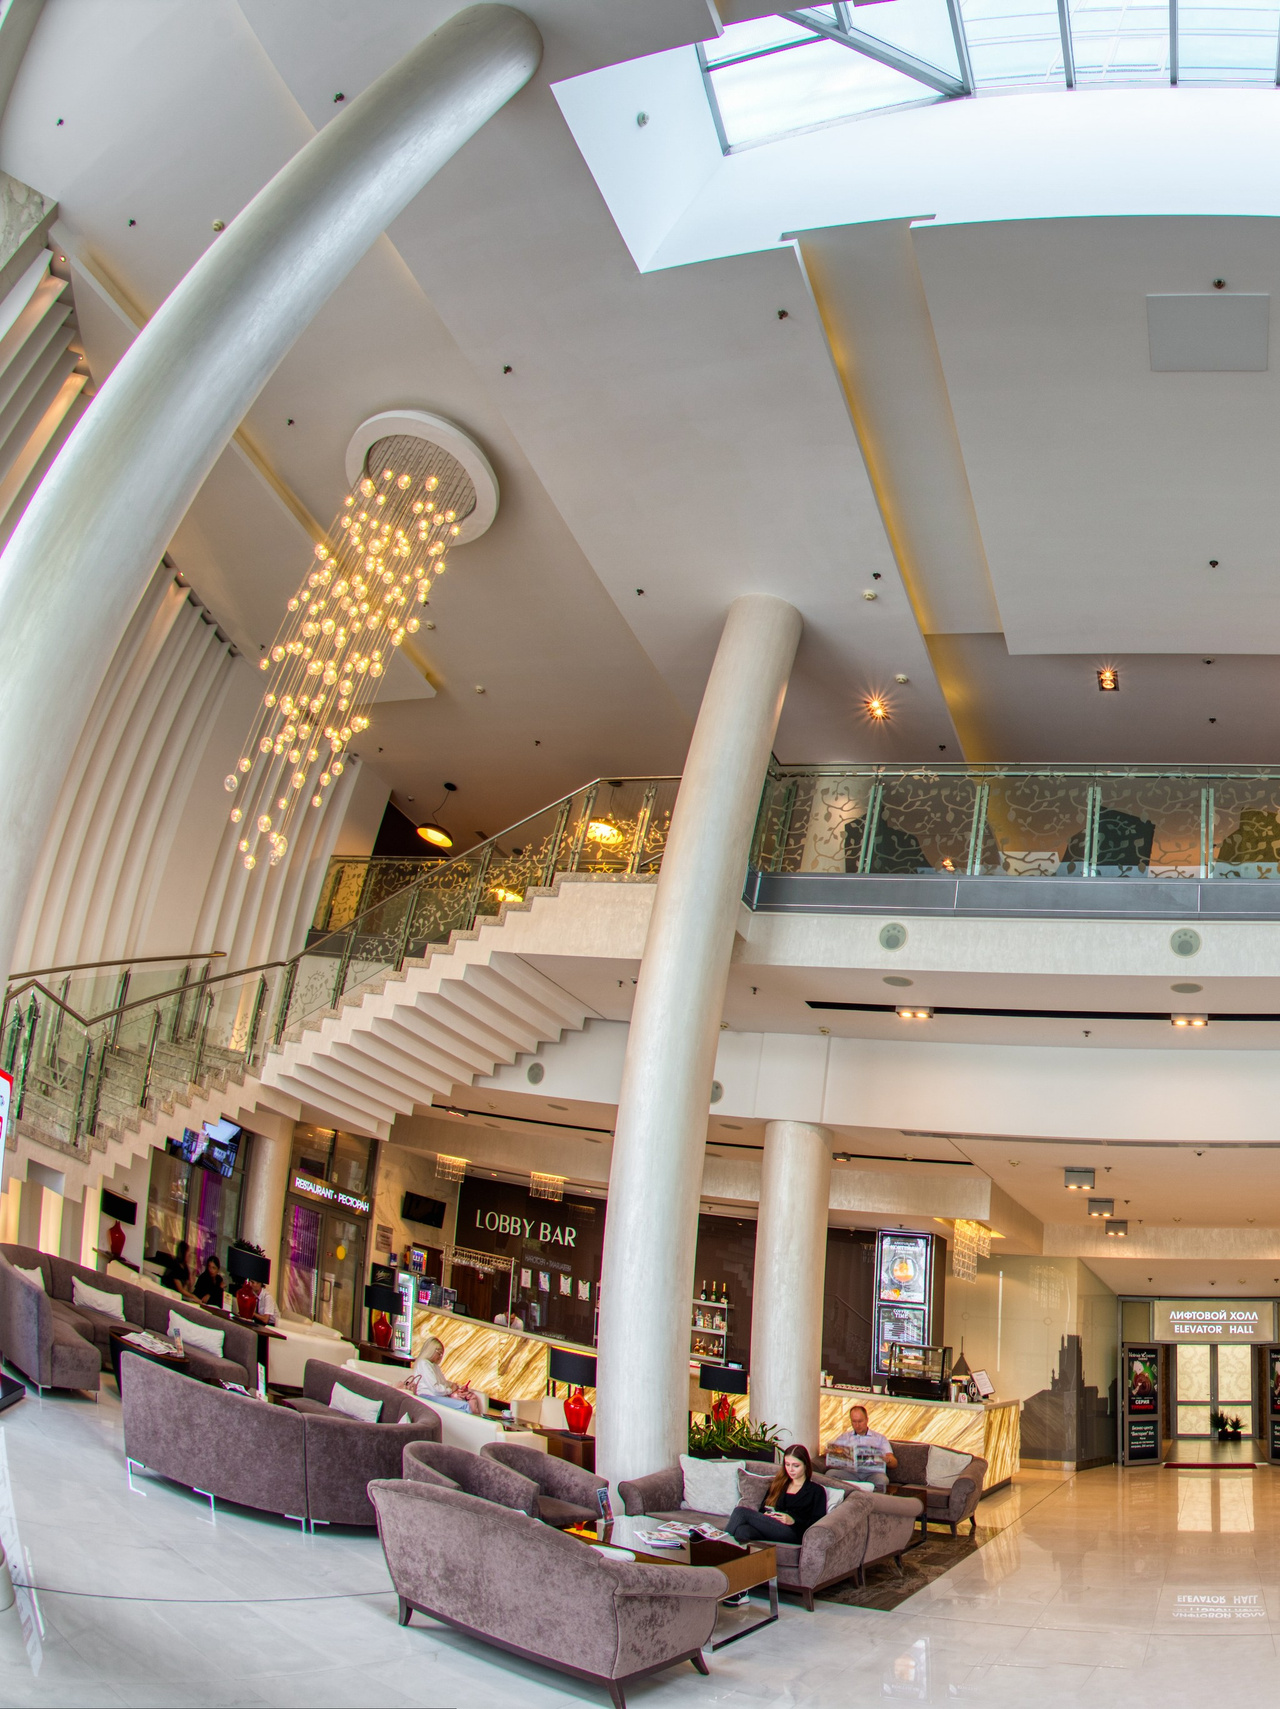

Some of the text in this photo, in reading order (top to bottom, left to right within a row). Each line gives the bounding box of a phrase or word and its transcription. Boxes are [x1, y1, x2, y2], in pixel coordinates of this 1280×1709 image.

[295, 1176, 370, 1212] RESTAURANT РЕСТОРАН
[475, 1209, 577, 1248] LOBBY BAR
[1169, 1309, 1259, 1320] ЛИФТОВОЙ ХОЛЛ
[1174, 1325, 1254, 1334] ELEVATOR HALL
